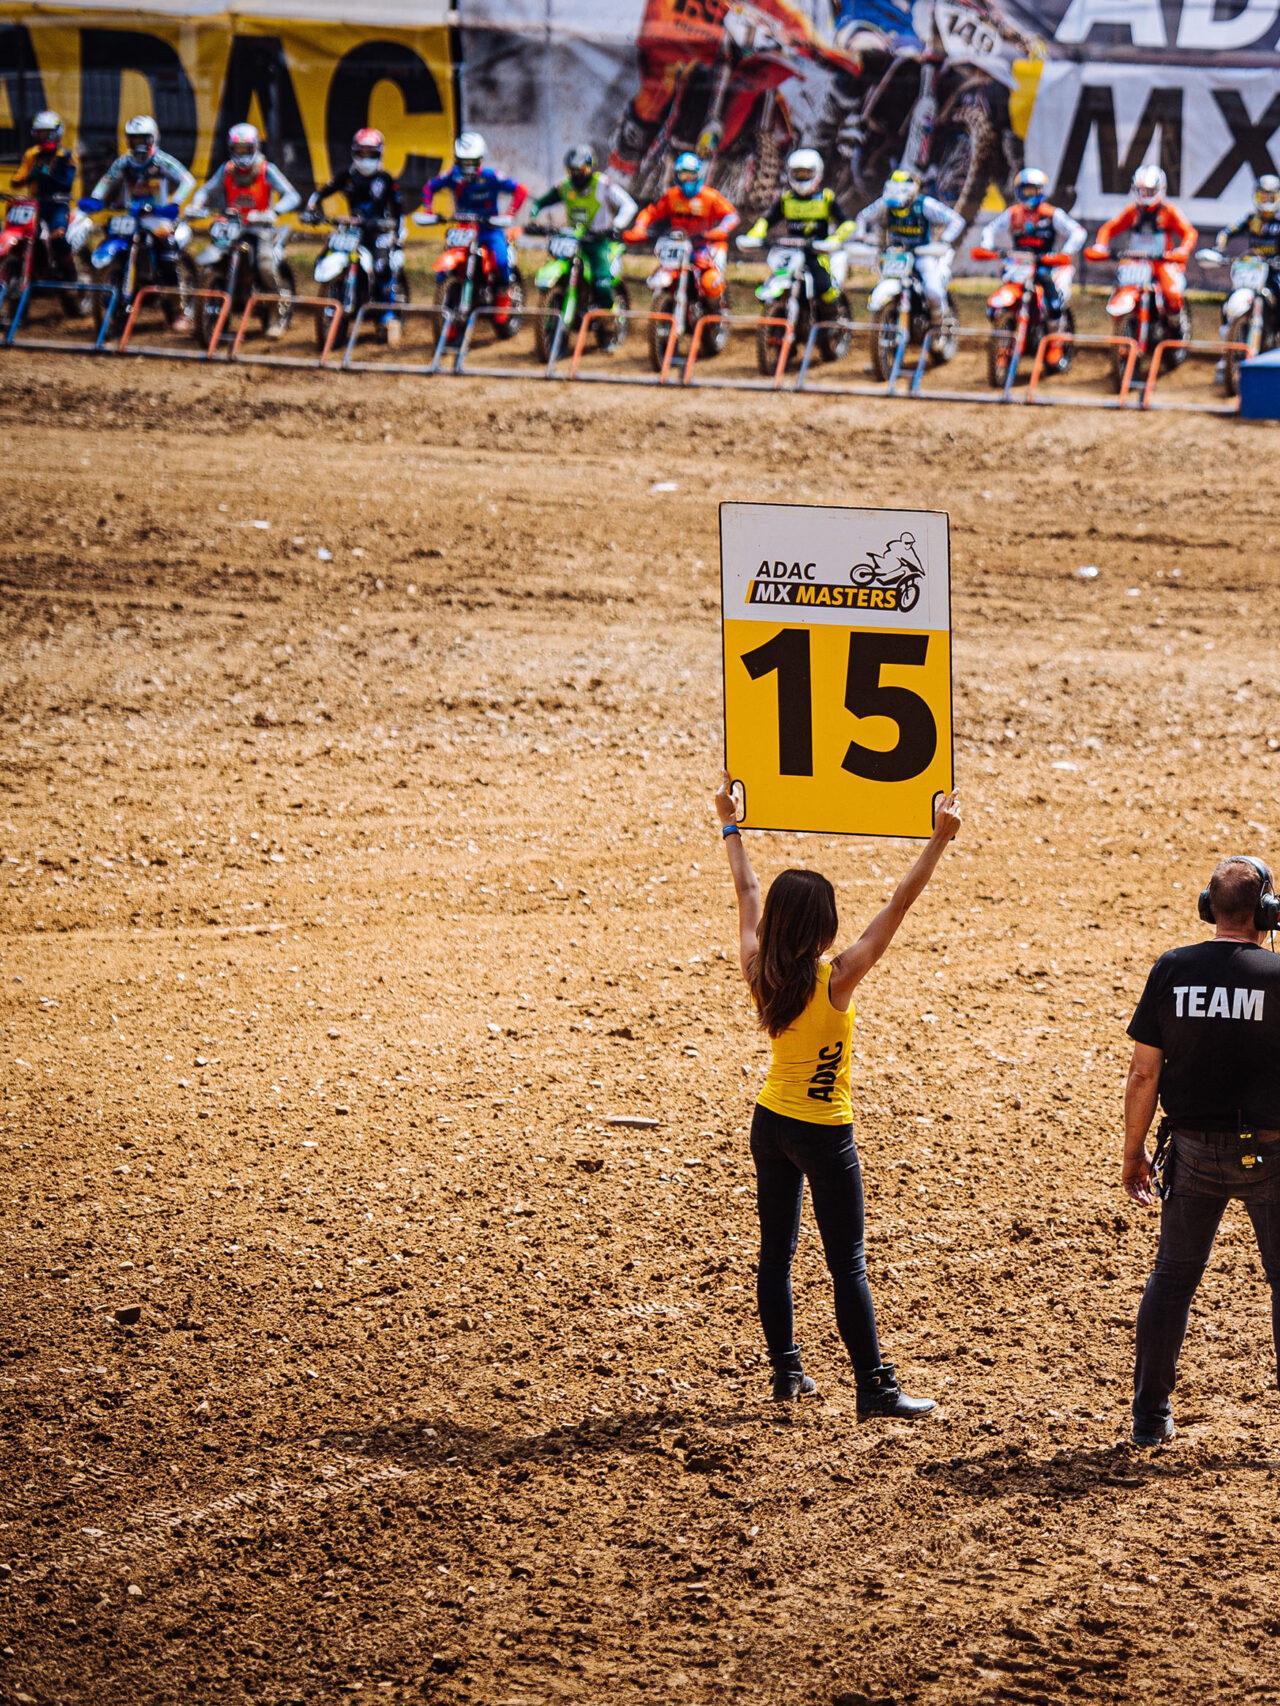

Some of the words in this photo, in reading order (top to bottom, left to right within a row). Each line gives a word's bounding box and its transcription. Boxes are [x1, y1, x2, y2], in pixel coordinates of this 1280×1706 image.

[756, 560, 816, 581] ADAC
[754, 583, 792, 603] MX
[795, 585, 897, 609] MASTERS
[740, 628, 937, 782] 15
[1173, 985, 1265, 1021] TEAM
[807, 1041, 843, 1103] ADAC
